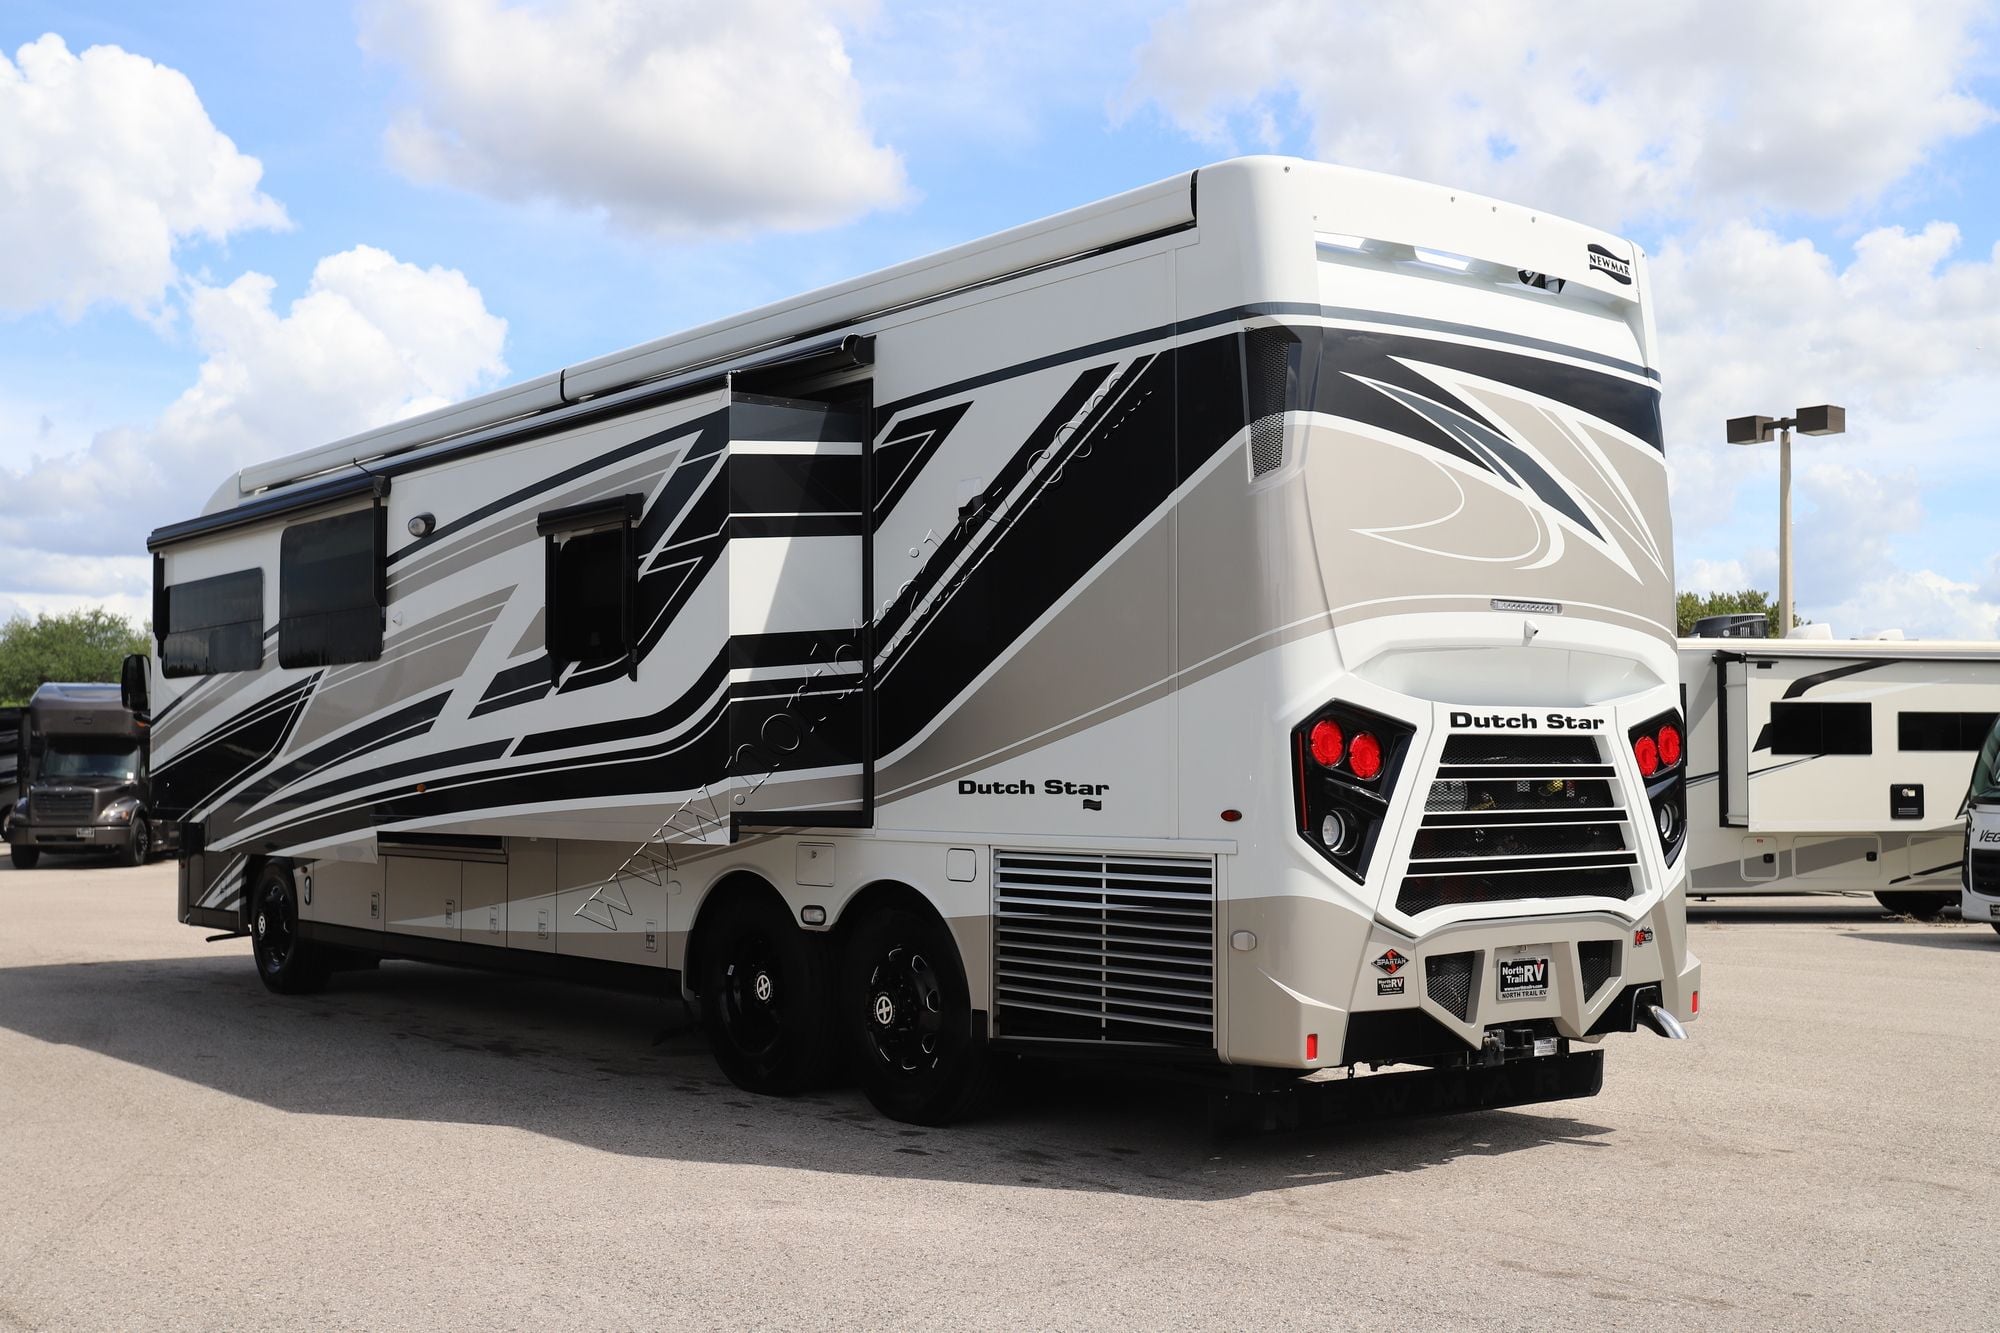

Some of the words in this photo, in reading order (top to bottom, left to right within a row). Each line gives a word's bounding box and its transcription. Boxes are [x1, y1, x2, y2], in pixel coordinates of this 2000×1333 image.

[1589, 253, 1631, 276] NEWMAR
[1449, 711, 1538, 729] Dutch
[1546, 713, 1605, 730] Star
[958, 779, 1036, 795] Dutch
[1044, 779, 1110, 796] Star
[1376, 957, 1406, 966] SPARTAN
[1502, 965, 1524, 976] North
[1524, 963, 1545, 982] RV
[1391, 978, 1404, 988] RV
[1506, 974, 1524, 984] Trail
[1502, 991, 1521, 999] NORTH
[1522, 990, 1538, 998] TRAIL
